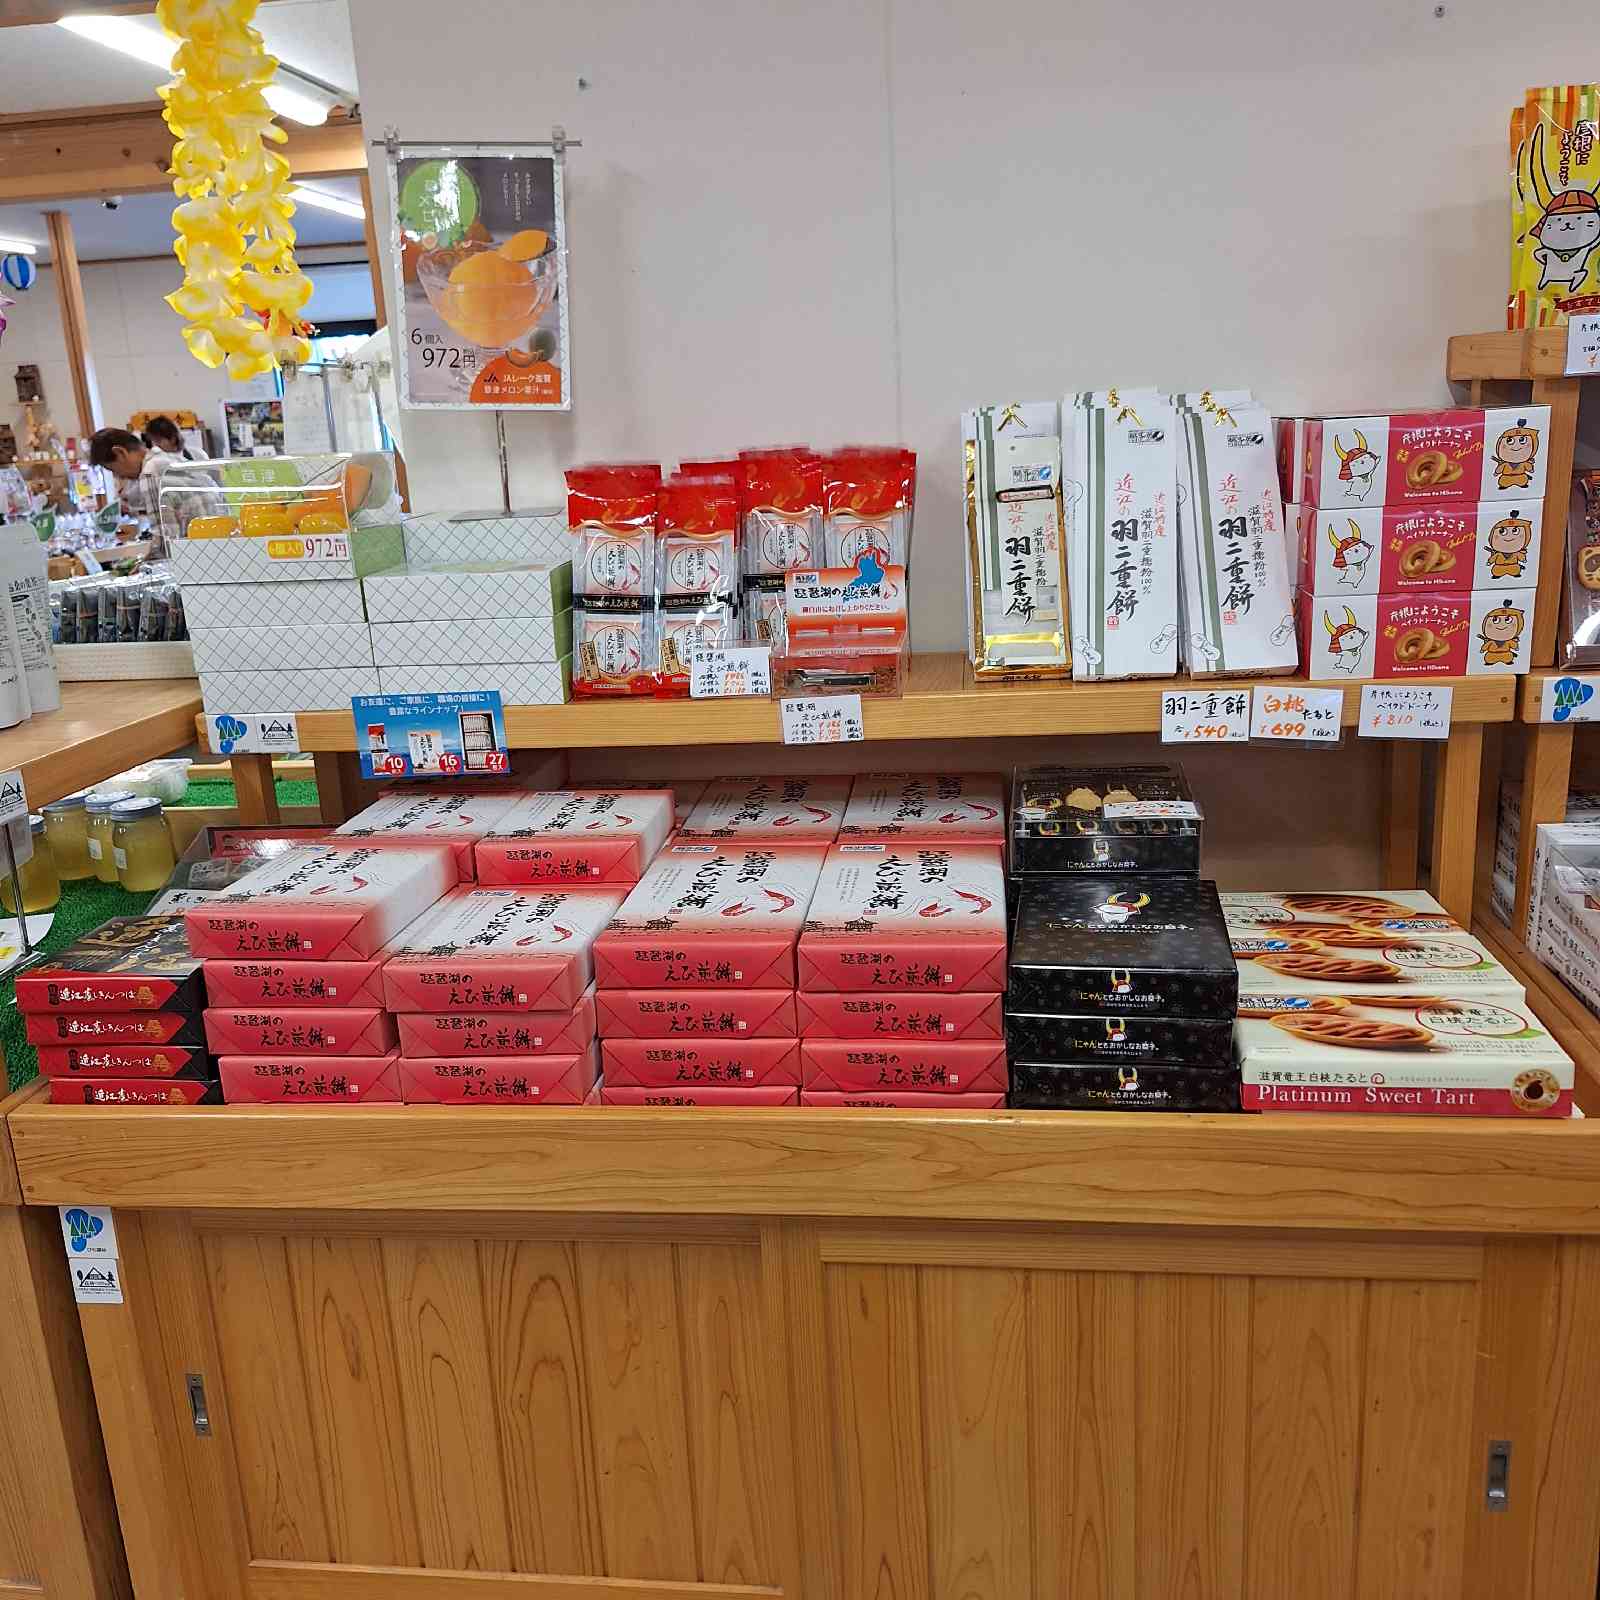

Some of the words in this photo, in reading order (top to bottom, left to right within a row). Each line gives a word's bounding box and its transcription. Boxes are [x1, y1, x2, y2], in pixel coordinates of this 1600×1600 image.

[422, 348, 476, 368] 972円
[1106, 518, 1139, 621] 羽二重餅
[1219, 516, 1255, 616] 羽二重餅
[1005, 535, 1037, 625] 羽二重餅
[1165, 693, 1247, 719] 羽二重餅
[1264, 694, 1305, 714] 白桃
[1302, 709, 1335, 720] たると
[387, 757, 404, 768] 10
[441, 755, 458, 766] 16
[489, 754, 505, 766] 27
[1258, 1085, 1351, 1103] Platinum
[1365, 1086, 1423, 1104] Sweet
[1431, 1088, 1477, 1106] Tart
